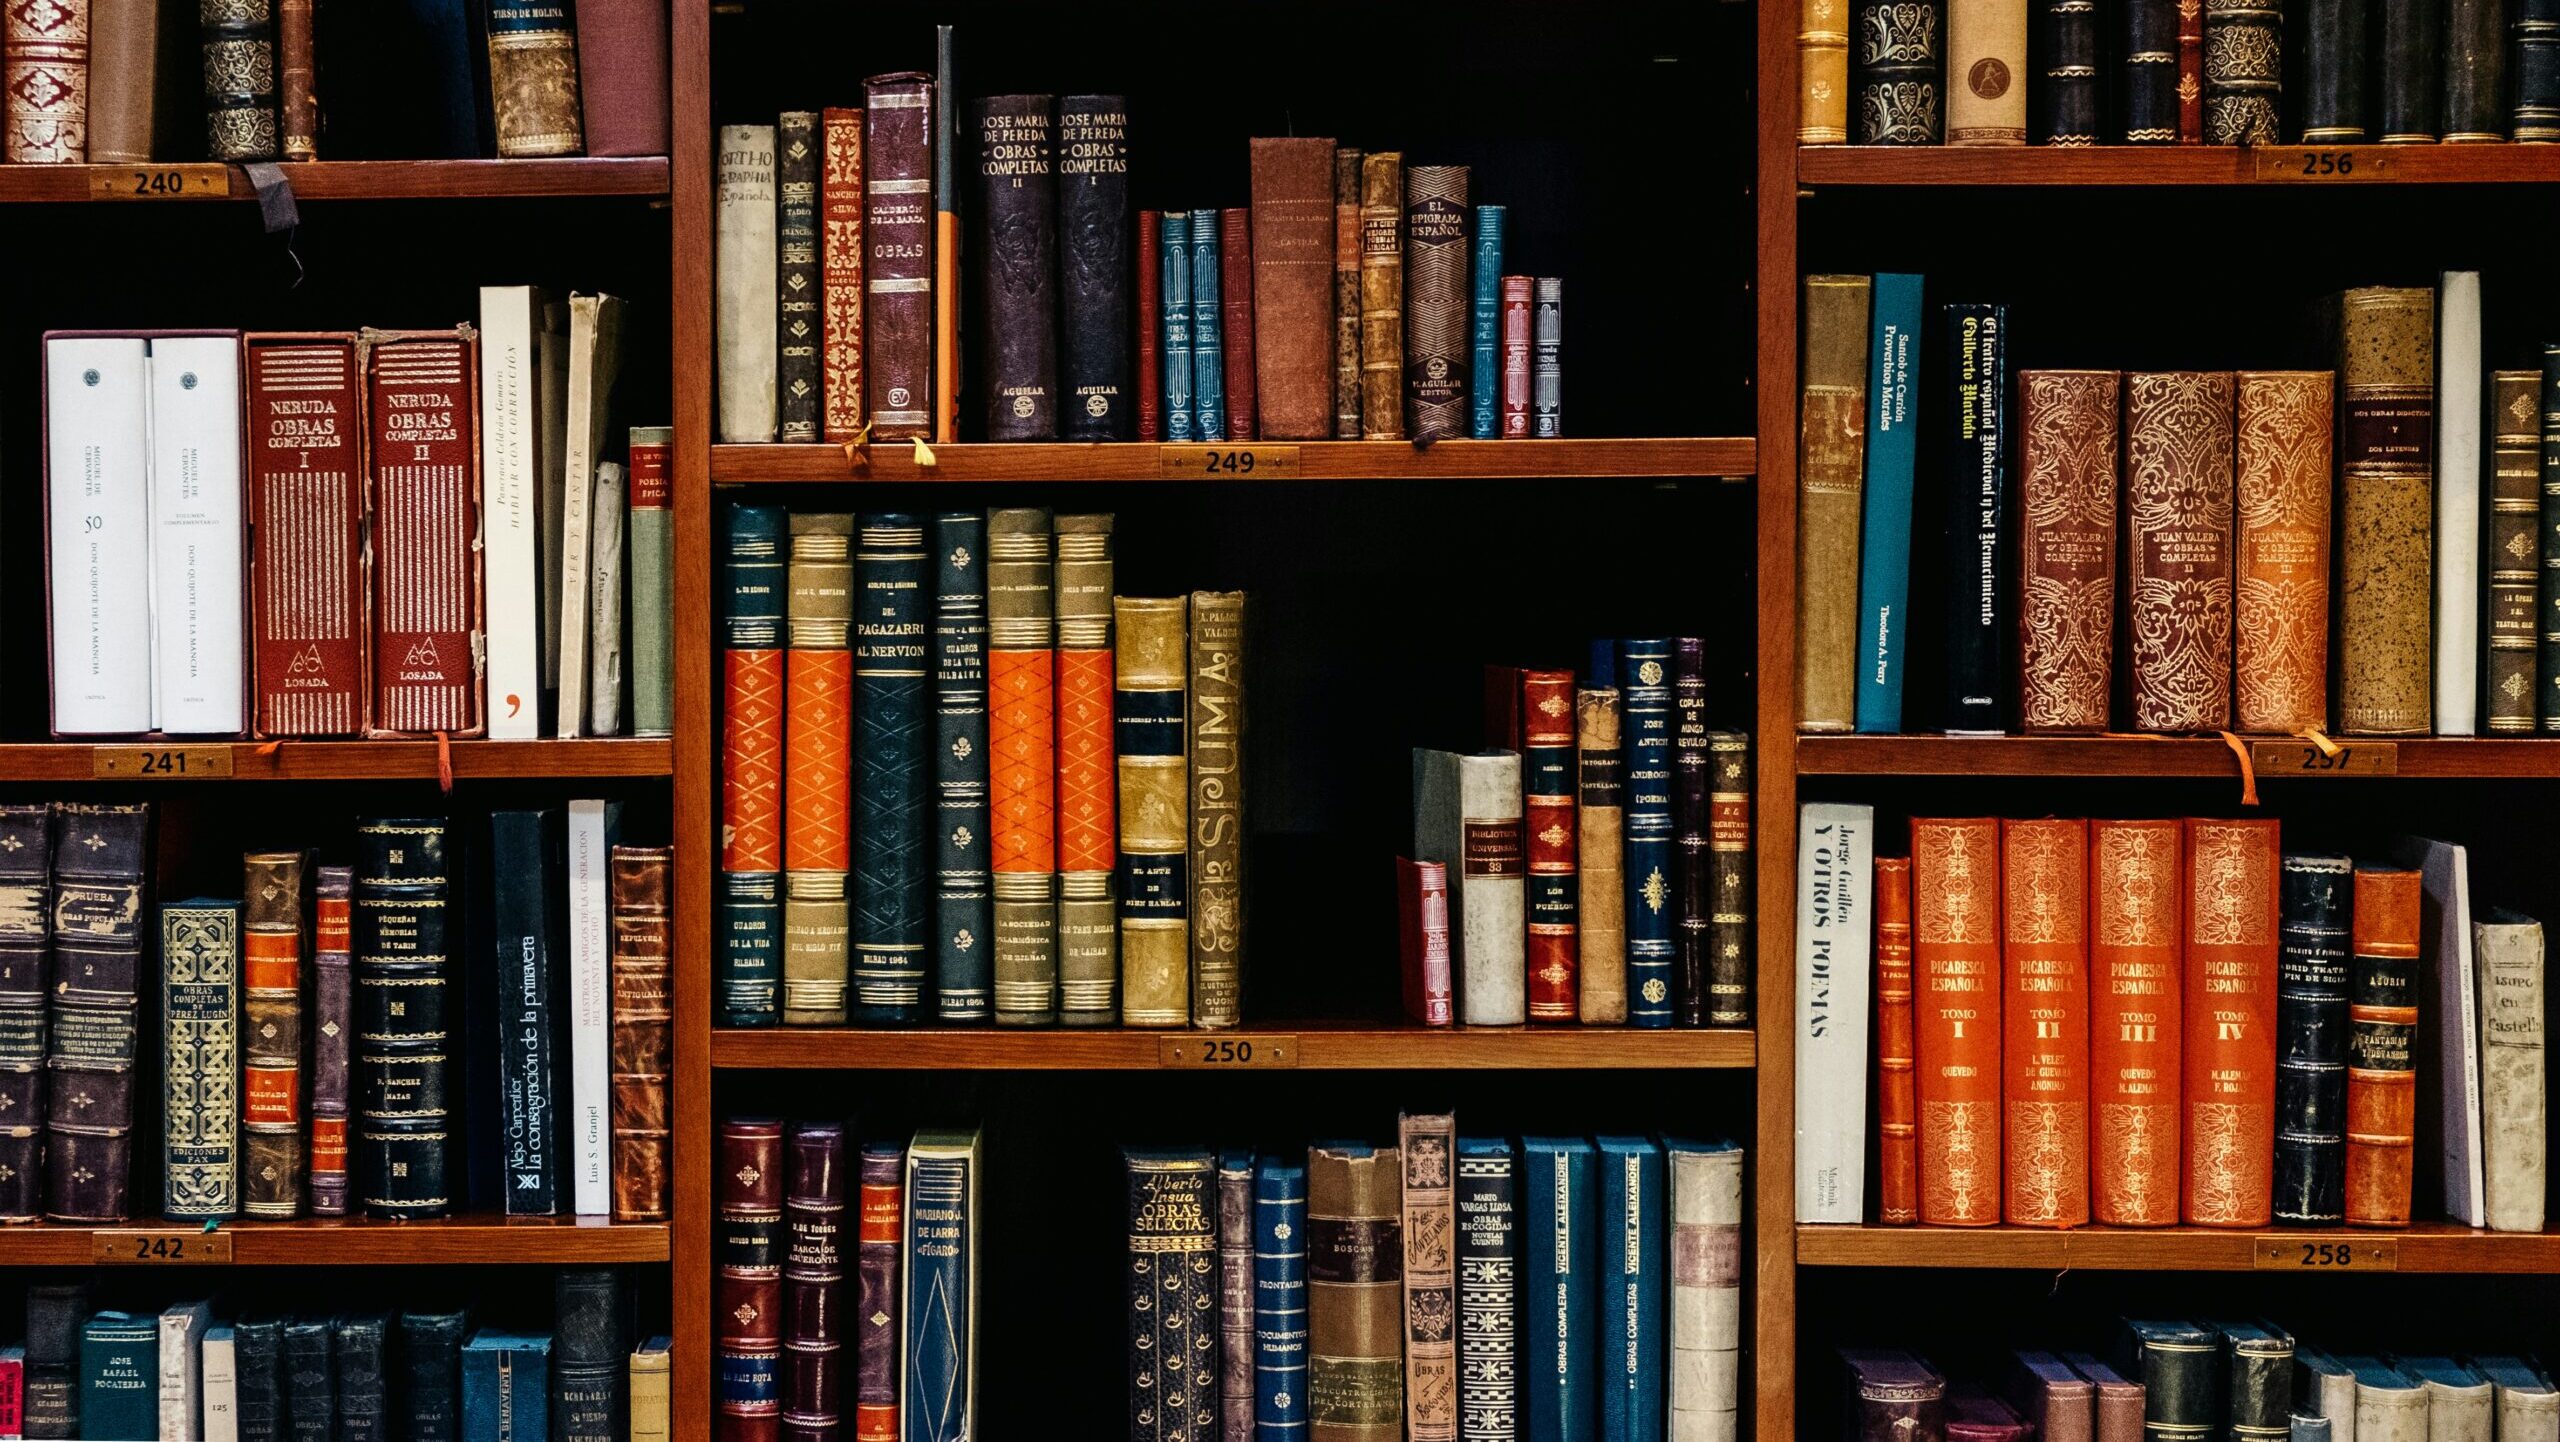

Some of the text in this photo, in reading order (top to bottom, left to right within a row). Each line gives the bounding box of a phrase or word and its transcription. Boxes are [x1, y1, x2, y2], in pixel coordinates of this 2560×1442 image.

[981, 115, 1049, 128] JOSE MARIA
[1060, 114, 1126, 126] JOSE MARIA
[984, 130, 1046, 142] DE PEREDA
[1063, 128, 1124, 140] DE PEREDA
[993, 145, 1037, 159] OBRAS
[1071, 144, 1114, 157] OBRAS
[983, 161, 1048, 175] COMPLETAS
[1061, 160, 1126, 174] COMPLETAS
[2302, 152, 2353, 175] 256
[134, 171, 183, 195] 240
[1013, 178, 1022, 187] II
[1429, 202, 1444, 211] EL
[1411, 214, 1462, 223] EPIGRAMA
[1411, 224, 1462, 236] ESPAÑOL
[875, 244, 923, 257] OBRAS
[1881, 325, 1896, 431] Proverbios Morales
[1896, 334, 1908, 422] Santob de Carrión
[1003, 387, 1044, 396] AGUILAR
[1077, 386, 1118, 395] AGUILAR
[388, 394, 453, 408] NERUDA
[270, 401, 337, 414] NERUDA
[271, 418, 335, 435] OBRAS
[388, 412, 451, 429] OBRAS
[386, 429, 457, 441] COMPLETAS
[505, 346, 520, 528] HABLAR CON CORRECCIÓN
[268, 436, 340, 448] COMPLETAS
[413, 445, 430, 460] II
[1206, 452, 1255, 473] 249
[572, 450, 581, 518] CANTAR
[2039, 532, 2107, 543] JUAN VALERA
[2153, 532, 2220, 543] JUAN VALERA
[2060, 544, 2092, 552] OBRAS
[2174, 544, 2205, 552] OBRAS
[2272, 544, 2304, 552] OBRAS
[2045, 554, 2102, 563] COMPLETAS
[2160, 554, 2216, 562] COMPLETAS
[2256, 554, 2315, 563] COMPLETAS
[882, 608, 896, 616] DEL
[858, 624, 924, 636] PAGAZARRI
[857, 646, 924, 657] AL NERVION
[946, 644, 978, 653] CUADROS
[943, 658, 981, 667] DE LA VIDA
[400, 672, 444, 680] LOSADA
[938, 671, 981, 680] BILBAINA
[284, 678, 329, 688] LOSADA
[1680, 699, 1704, 708] COPLAS
[1687, 712, 1696, 720] DE
[1644, 720, 1663, 728] JOSE
[1681, 724, 1703, 733] MINGO
[1678, 738, 1707, 746] REVULGO
[141, 752, 187, 773] 241
[1472, 830, 1517, 838] BIBLIOTECA
[734, 922, 766, 930] CUADROS
[1810, 824, 1833, 1039] Y OTROS POEMAS
[85, 965, 94, 976] 2
[1930, 960, 1986, 974] PICARESCA
[2020, 960, 2074, 974] PICARESCA
[2111, 963, 2166, 977] PICARESCA
[2205, 962, 2259, 976] PICARESCA
[1932, 977, 1984, 991] ESPAÑOLA
[2021, 977, 2072, 991] ESPAÑOLA
[2112, 980, 2164, 994] ESPAÑOLA
[184, 986, 213, 995] OBRAS
[174, 995, 223, 1004] COMPLETAS
[1940, 1009, 1977, 1019] TOMO
[2030, 1009, 2065, 1019] TOMO
[2120, 1012, 2156, 1022] TOMO
[2214, 1011, 2249, 1021] TOMO
[1953, 1021, 1965, 1038] I
[2036, 1021, 2060, 1038] II
[2120, 1024, 2157, 1042] III
[2218, 1023, 2247, 1040] IV
[520, 936, 545, 1170] La consagración de la primavera
[1203, 1042, 1252, 1062] 250
[1942, 1066, 1977, 1078] QUEVEDO
[2120, 1068, 2156, 1079] QUEVEDO
[587, 1105, 598, 1144] Granjel
[173, 1148, 224, 1156] EDICIONES
[188, 1155, 208, 1163] FAX
[589, 1157, 598, 1184] Luis
[1143, 1175, 1202, 1190] Alberto
[1150, 1191, 1194, 1203] Insua
[916, 1209, 963, 1220] MARIANO J.
[1142, 1204, 1201, 1217] OBRAS
[1557, 1157, 1566, 1272] VICENTE ALEIXANDRE
[1628, 1158, 1637, 1272] VICENTE ALEIXANDRE
[1136, 1217, 1211, 1231] SELECTAS
[918, 1227, 960, 1238] DE LARRA
[137, 1238, 184, 1259] 242
[2302, 1244, 2351, 1266] 258
[1558, 1283, 1566, 1373] OBRAS COMPLETAS
[1627, 1283, 1636, 1373] OBRAS COMPLETAS
[103, 1369, 138, 1377] RAFAEL
[95, 1380, 146, 1388] POCATERRA
[501, 1366, 510, 1431] BENAVENTE
[212, 1404, 227, 1412] 125
